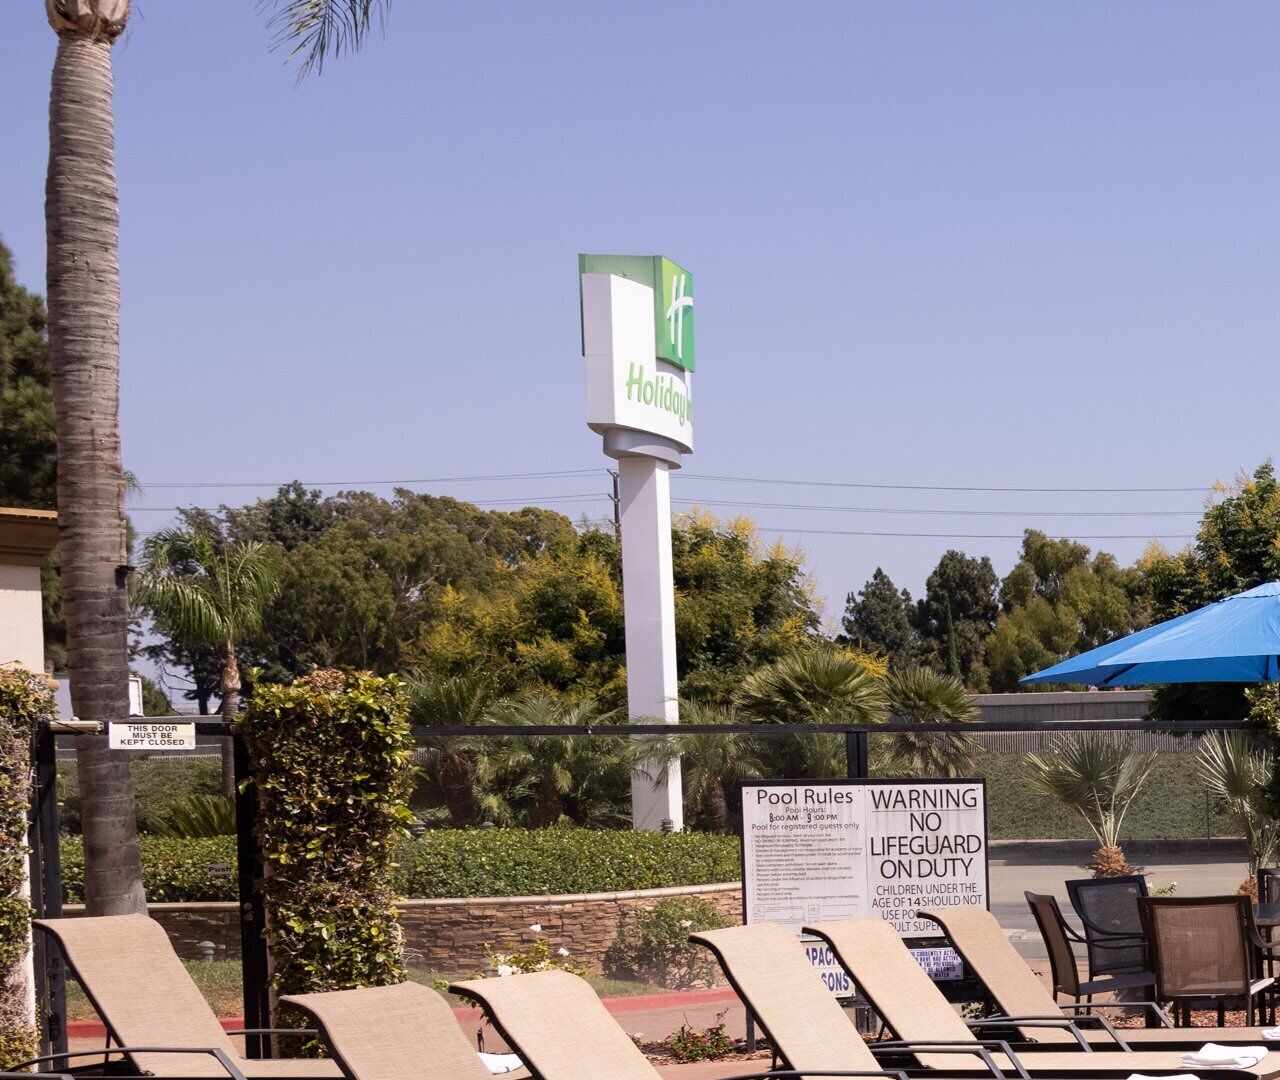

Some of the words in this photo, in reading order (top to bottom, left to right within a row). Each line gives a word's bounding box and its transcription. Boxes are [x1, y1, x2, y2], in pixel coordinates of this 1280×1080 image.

[626, 362, 685, 427] Holiday
[757, 788, 797, 804] Pool
[804, 788, 853, 804] Rules
[871, 789, 977, 809] WARNING
[769, 813, 785, 823] 8:00
[910, 812, 941, 831] NO
[782, 823, 817, 831] registered
[819, 823, 842, 831] guests
[871, 835, 981, 855] LIFEGUARD
[881, 859, 912, 878] ON
[918, 858, 973, 877] DUTY
[877, 885, 922, 895] CHILDREN
[926, 884, 957, 894] UNDER
[960, 883, 977, 892] THE
[872, 898, 890, 908] AGE
[893, 898, 906, 907] OF
[907, 898, 920, 906] 14
[922, 896, 960, 906] SHOULD
[963, 895, 982, 905] NOT
[882, 910, 899, 920] USE
[821, 972, 849, 991] SONS
